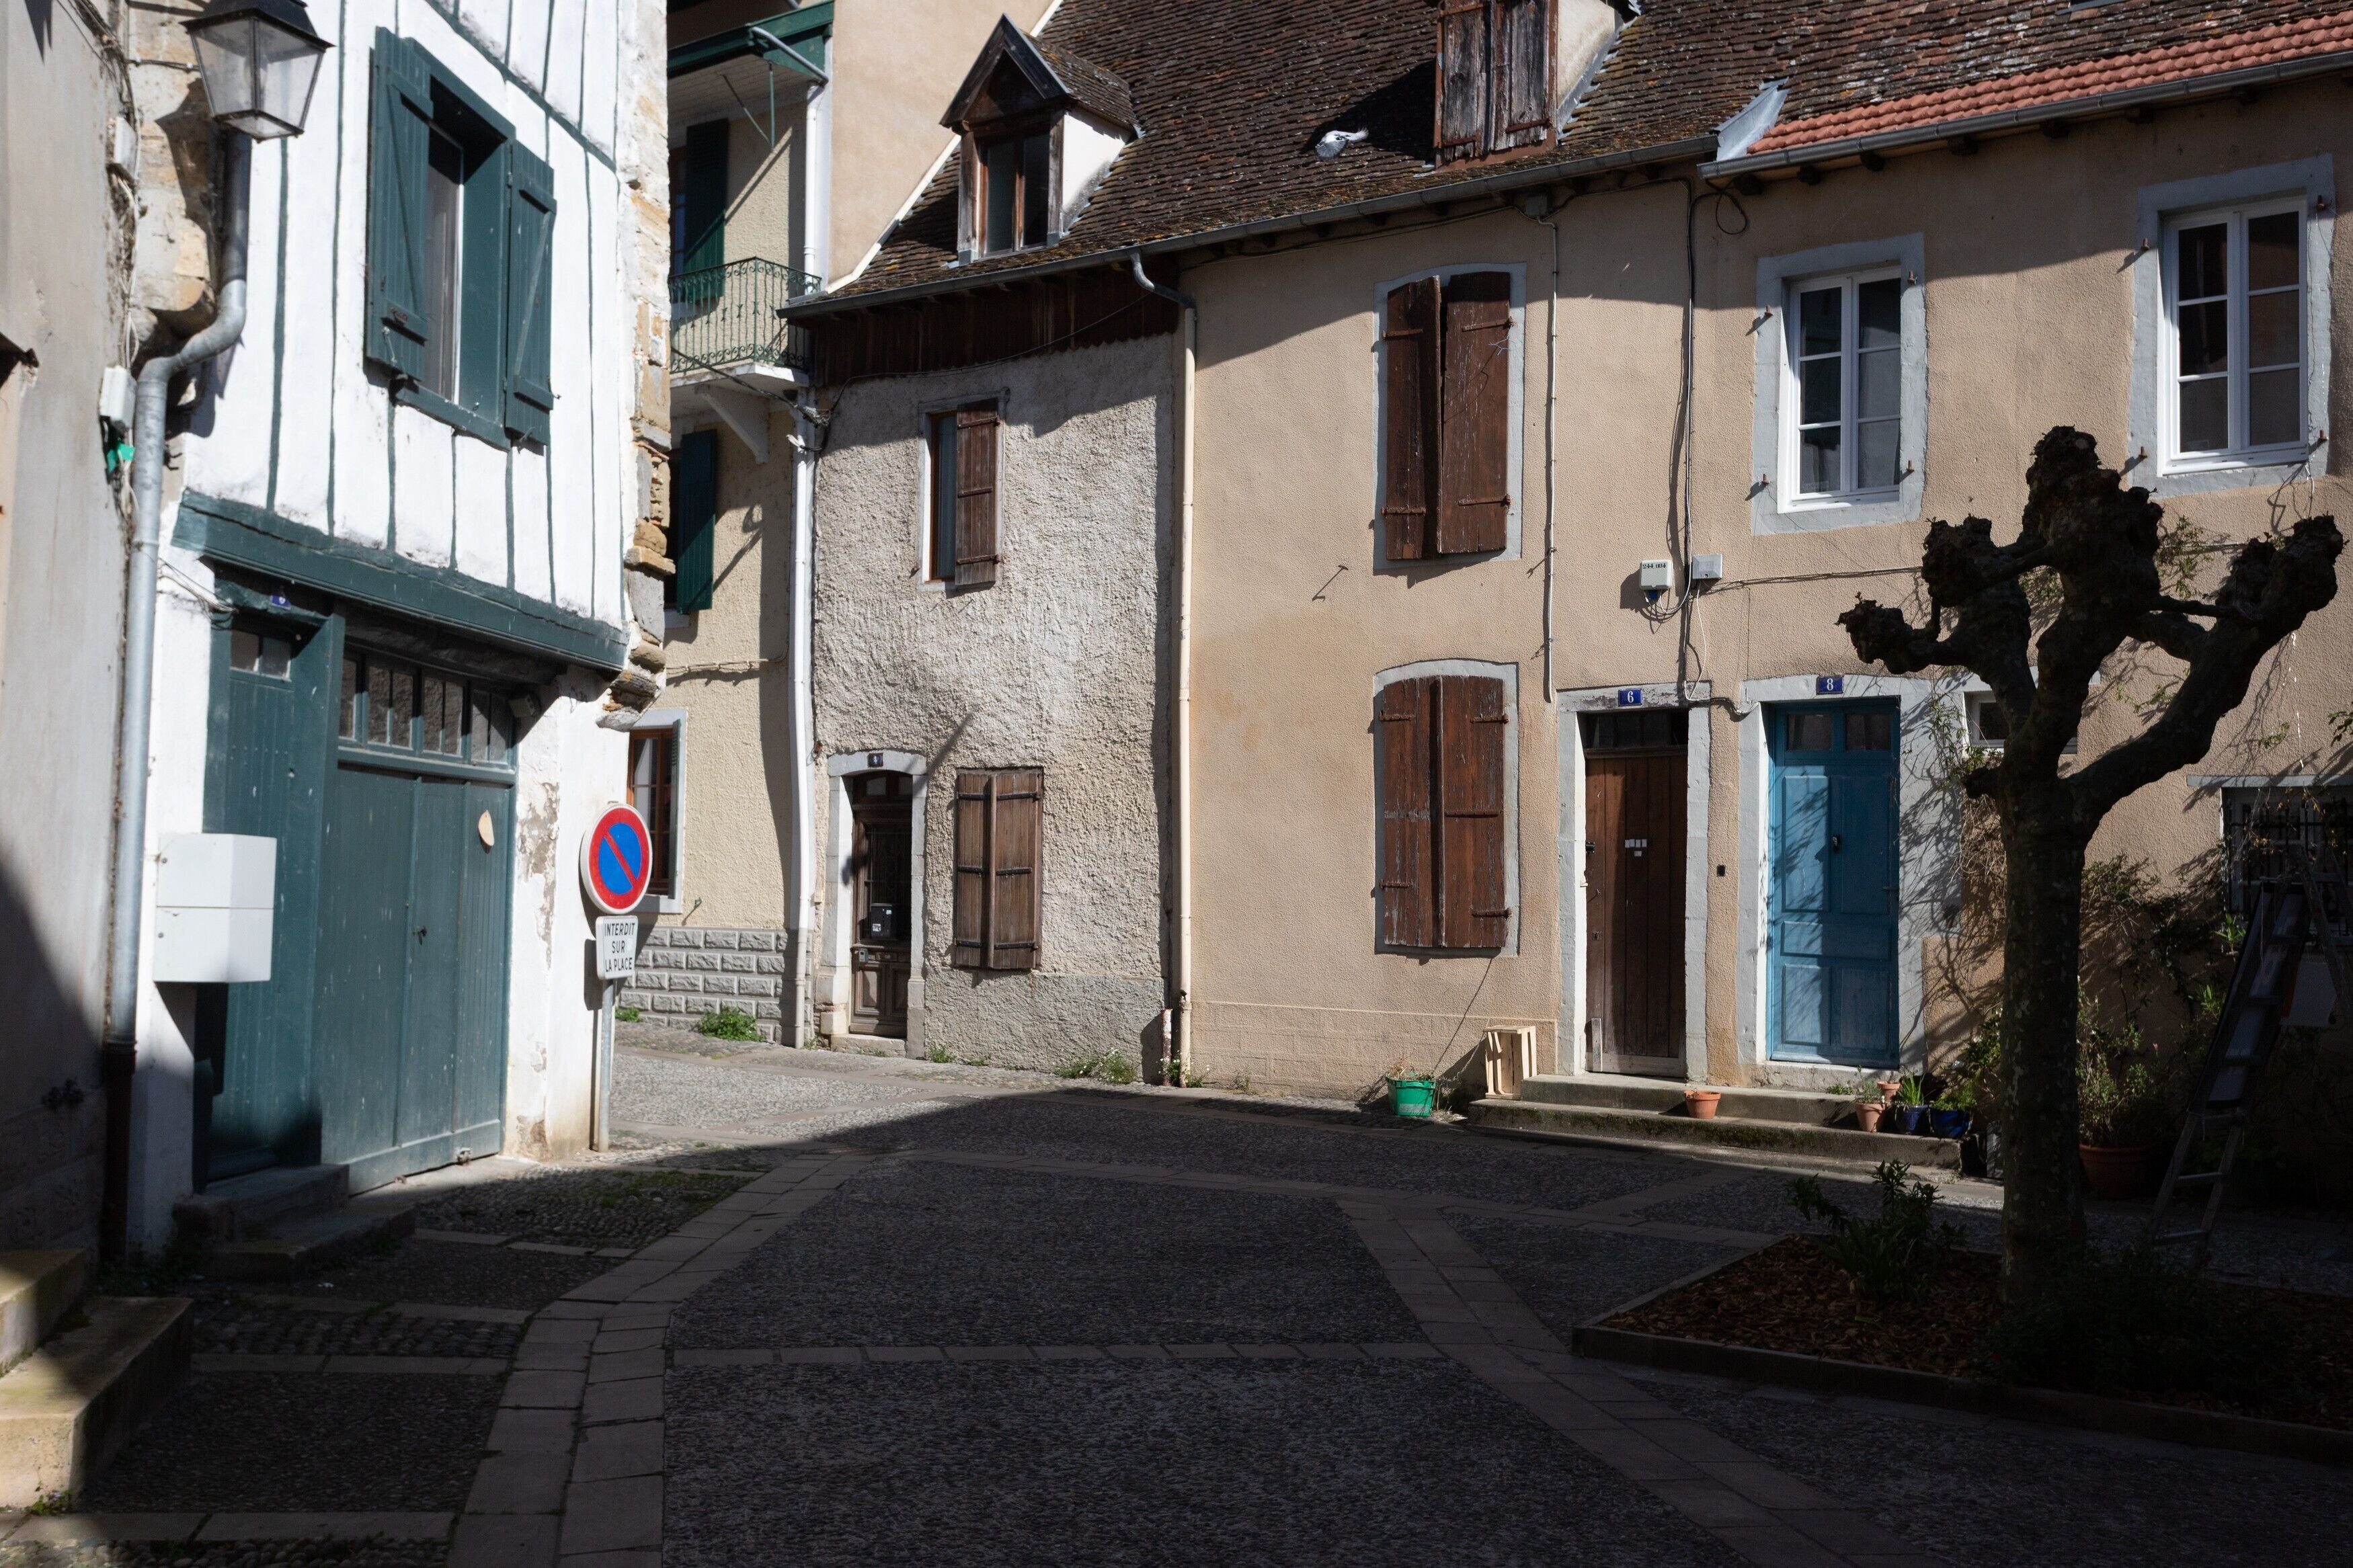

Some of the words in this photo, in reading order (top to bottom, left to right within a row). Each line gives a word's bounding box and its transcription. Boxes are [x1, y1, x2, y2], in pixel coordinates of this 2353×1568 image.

[1827, 678, 1833, 691] 8
[1627, 690, 1634, 703] 6
[605, 922, 635, 936] INTERDIT
[612, 940, 625, 954] SUR
[605, 959, 612, 973] LA
[614, 957, 633, 971] PLACE
